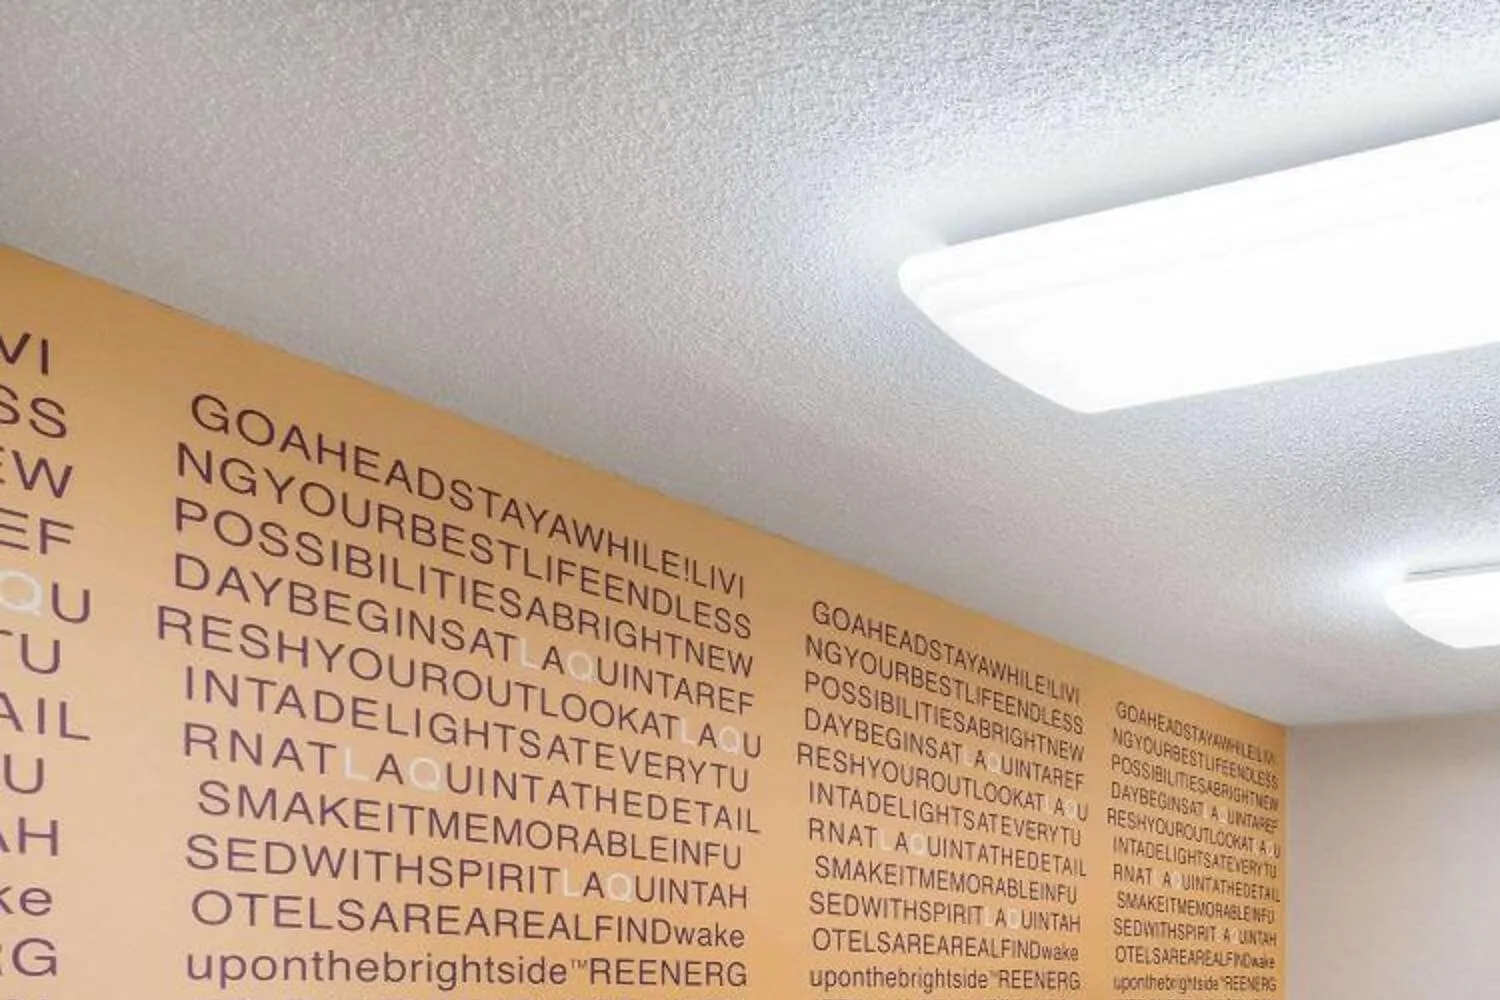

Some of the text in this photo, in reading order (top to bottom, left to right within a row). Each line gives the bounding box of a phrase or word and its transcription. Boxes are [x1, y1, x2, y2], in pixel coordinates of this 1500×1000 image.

[0, 447, 73, 498] W
[0, 815, 59, 857] H
[0, 938, 57, 977] G
